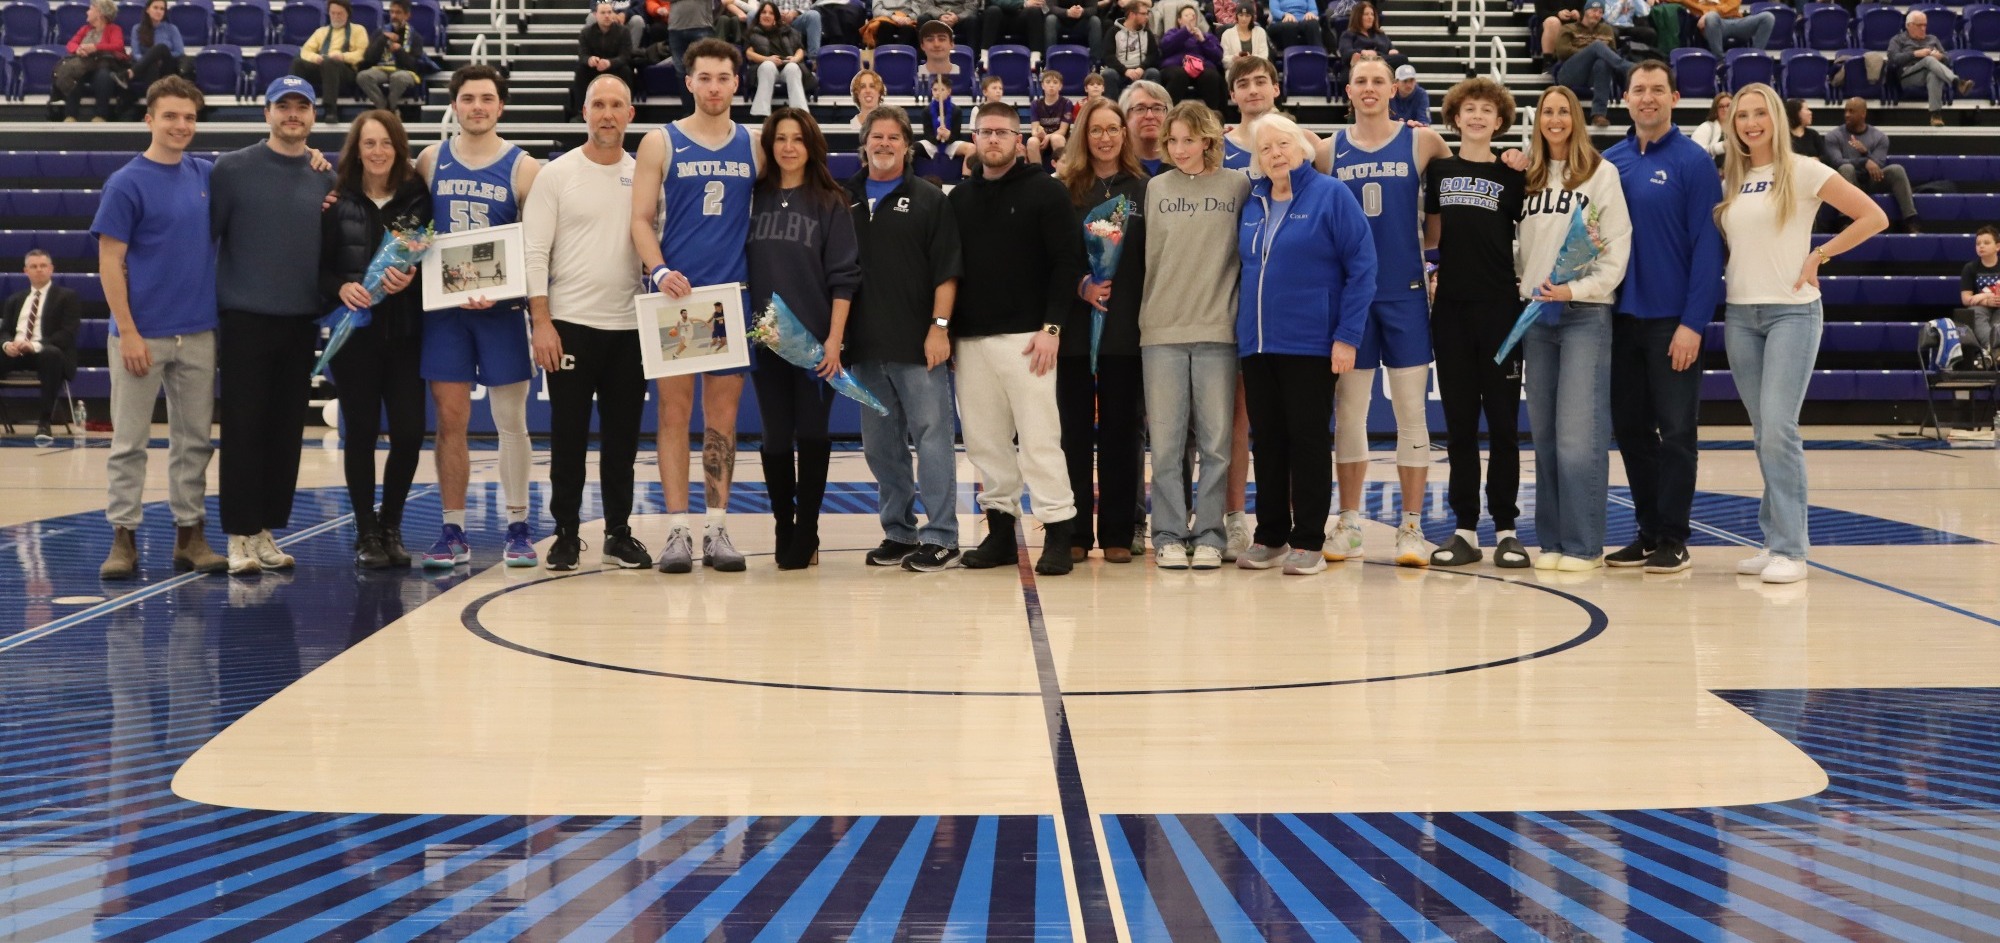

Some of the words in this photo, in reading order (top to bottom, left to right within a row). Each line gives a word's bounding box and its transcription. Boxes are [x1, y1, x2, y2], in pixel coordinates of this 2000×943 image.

[677, 161, 751, 178] MULES
[1337, 162, 1408, 181] MULES
[437, 179, 507, 202] MULES
[1440, 177, 1504, 198] COLBY
[703, 181, 725, 216] 2
[898, 197, 910, 209] C
[1159, 197, 1199, 217] Colby
[1204, 197, 1236, 213] Dad
[1362, 183, 1382, 217] 0
[450, 200, 490, 233] 55
[560, 354, 576, 370] C
